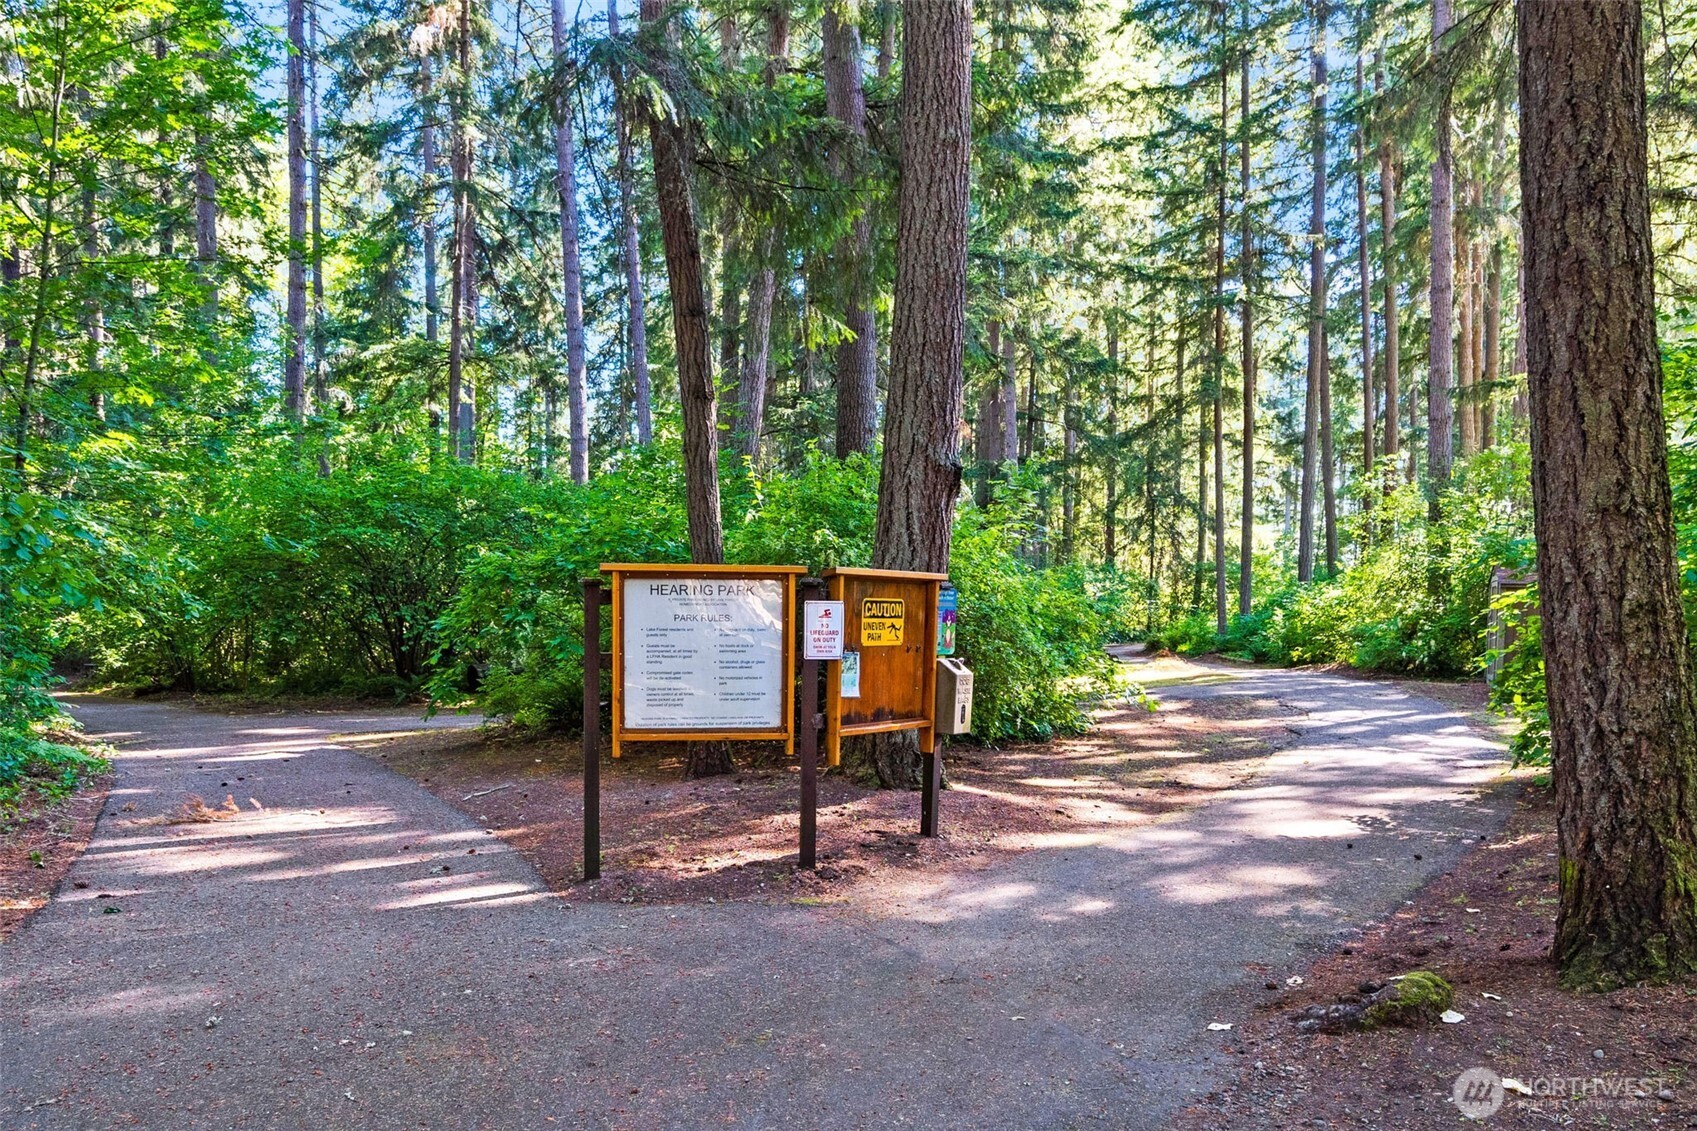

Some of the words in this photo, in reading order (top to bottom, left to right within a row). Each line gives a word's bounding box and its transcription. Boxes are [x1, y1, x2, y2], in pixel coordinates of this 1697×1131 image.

[650, 584, 713, 596] HEARING
[718, 584, 754, 596] PARK
[865, 602, 902, 617] CAUTION
[674, 614, 698, 622] PARK
[700, 614, 733, 622] RULES:
[863, 622, 886, 631] UNEVEN
[867, 632, 882, 641] PATH
